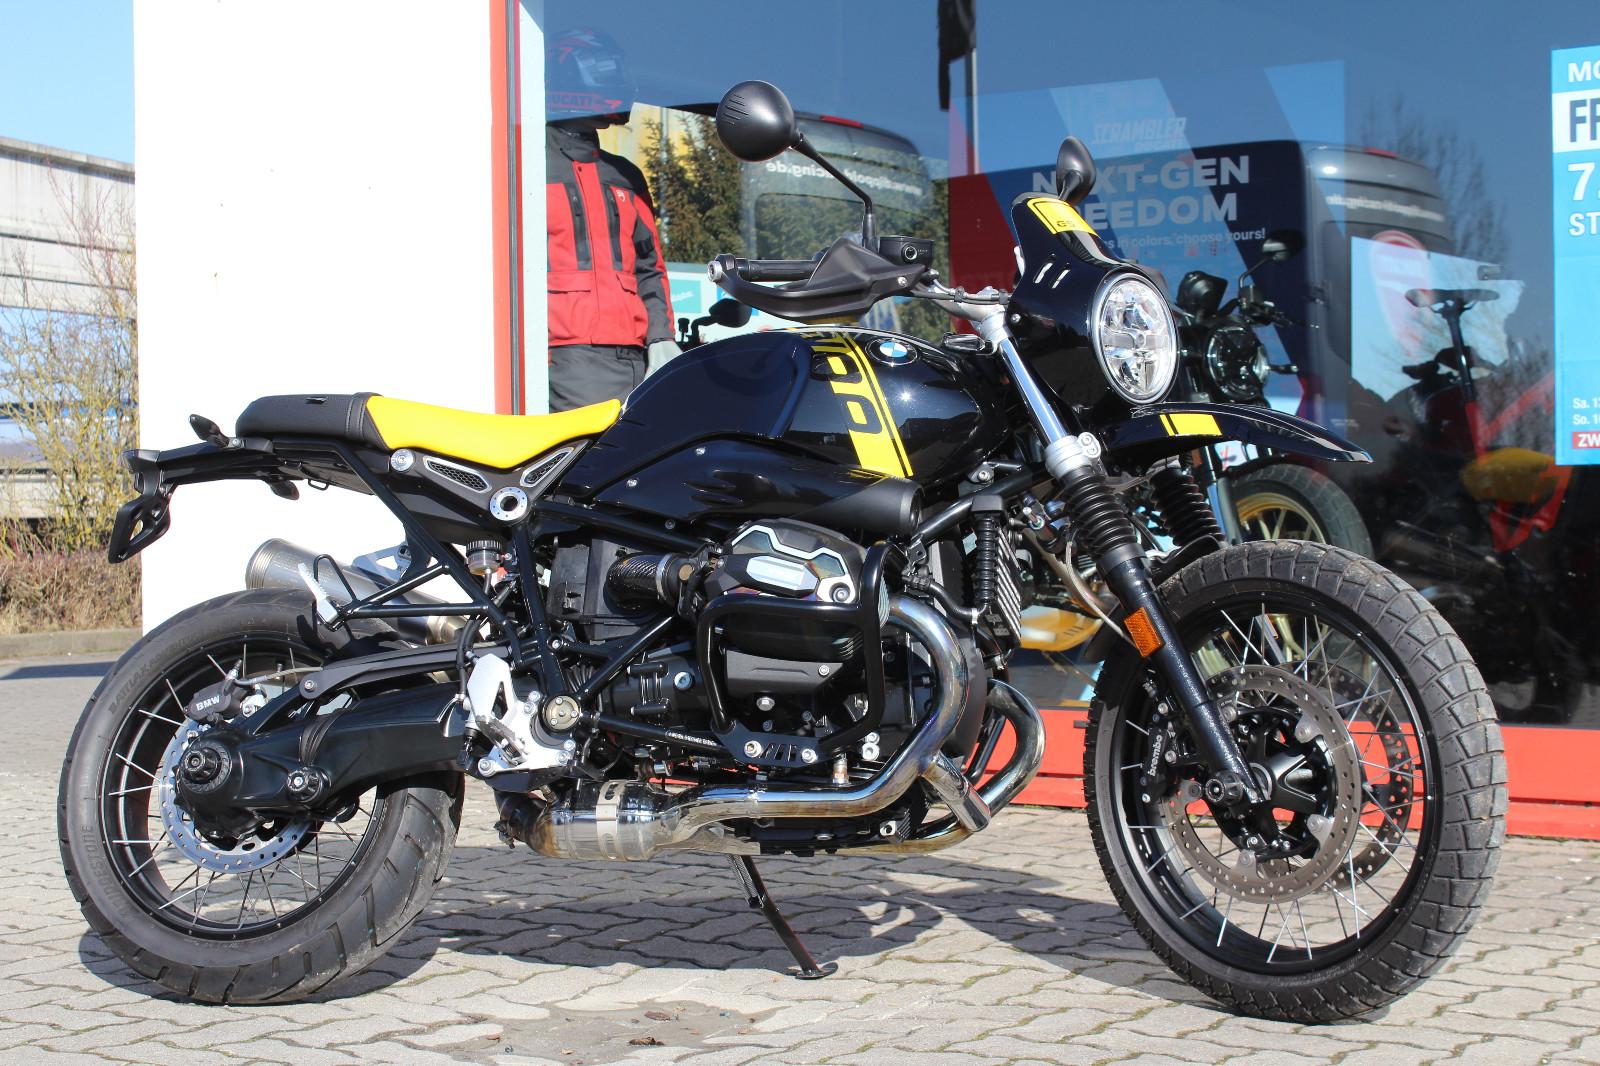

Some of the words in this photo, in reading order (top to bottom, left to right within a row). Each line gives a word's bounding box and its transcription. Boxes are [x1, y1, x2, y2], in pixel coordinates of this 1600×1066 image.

[1032, 155, 1250, 194] NXT-GEN
[1076, 193, 1239, 231] EEDOM
[1176, 231, 1223, 246] choose
[1226, 228, 1266, 245] yours!
[196, 695, 220, 711] BMW
[1148, 735, 1163, 777] brembo
